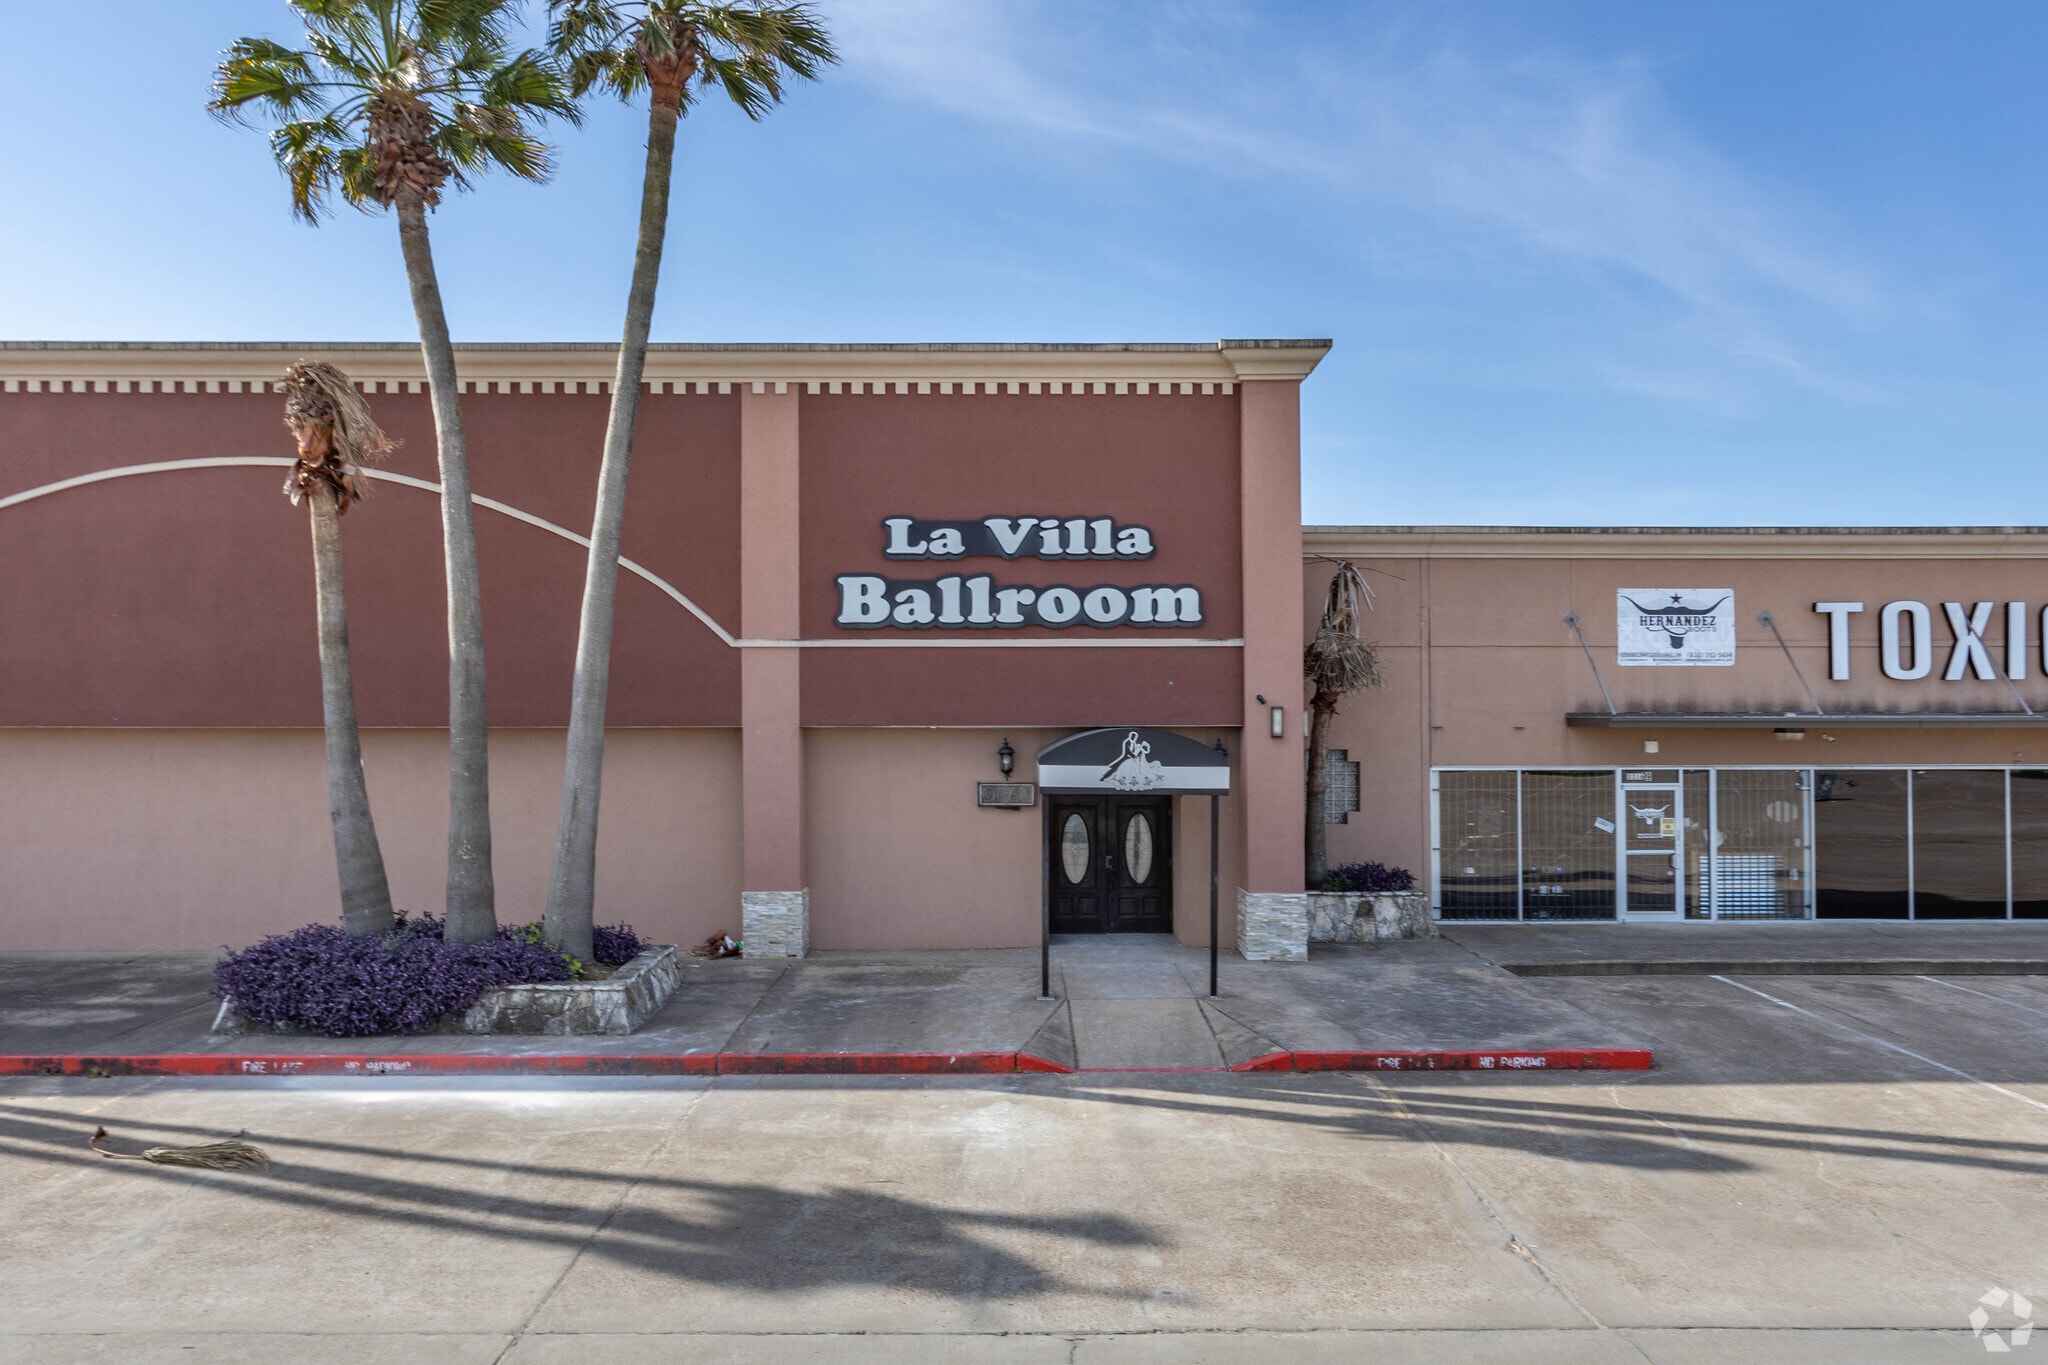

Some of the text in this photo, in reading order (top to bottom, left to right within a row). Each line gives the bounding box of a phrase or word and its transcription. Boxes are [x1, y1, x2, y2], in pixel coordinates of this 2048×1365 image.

[884, 518, 1154, 556] La Villa
[837, 576, 1202, 624] Ballroom
[1639, 616, 1716, 626] HERNANDEZ
[1813, 600, 2048, 681] TOXI
[982, 786, 1032, 803] OPEN
[1478, 1056, 1496, 1069] NO
